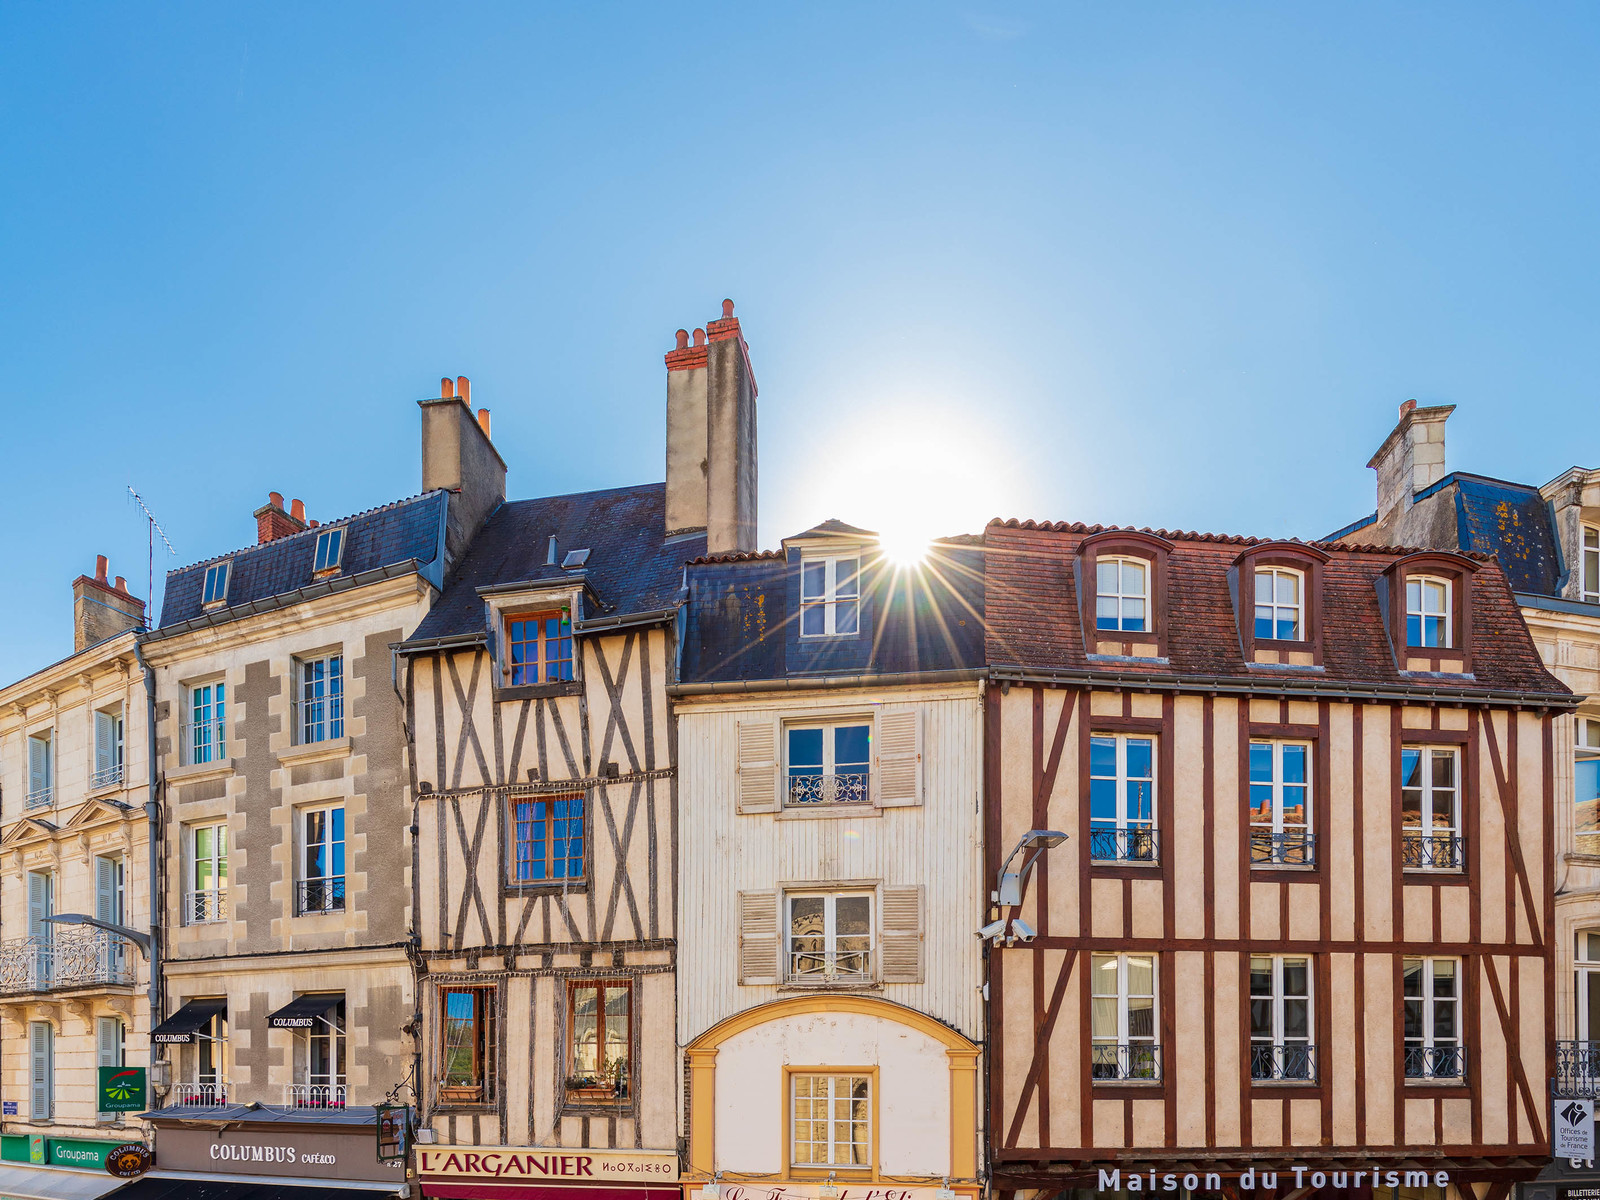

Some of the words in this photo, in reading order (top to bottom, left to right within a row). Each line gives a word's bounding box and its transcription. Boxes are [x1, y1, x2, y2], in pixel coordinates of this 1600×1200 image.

[273, 1018, 313, 1027] COLUMBUS
[154, 1034, 190, 1042] COLUMBUS
[1560, 1134, 1588, 1142] Tourisme
[1567, 1142, 1588, 1150] France
[56, 1146, 99, 1162] Groupama
[110, 1145, 150, 1160] COLUMBUS
[210, 1144, 296, 1163] COLUMBUS
[302, 1153, 336, 1164] CAFÉ&CO
[421, 1152, 593, 1176] L'ARGANIER
[1098, 1168, 1222, 1192] Maison
[1240, 1168, 1278, 1190] du
[1291, 1166, 1450, 1190] Tourisme
[1568, 1188, 1600, 1197] BILLETTERIE
